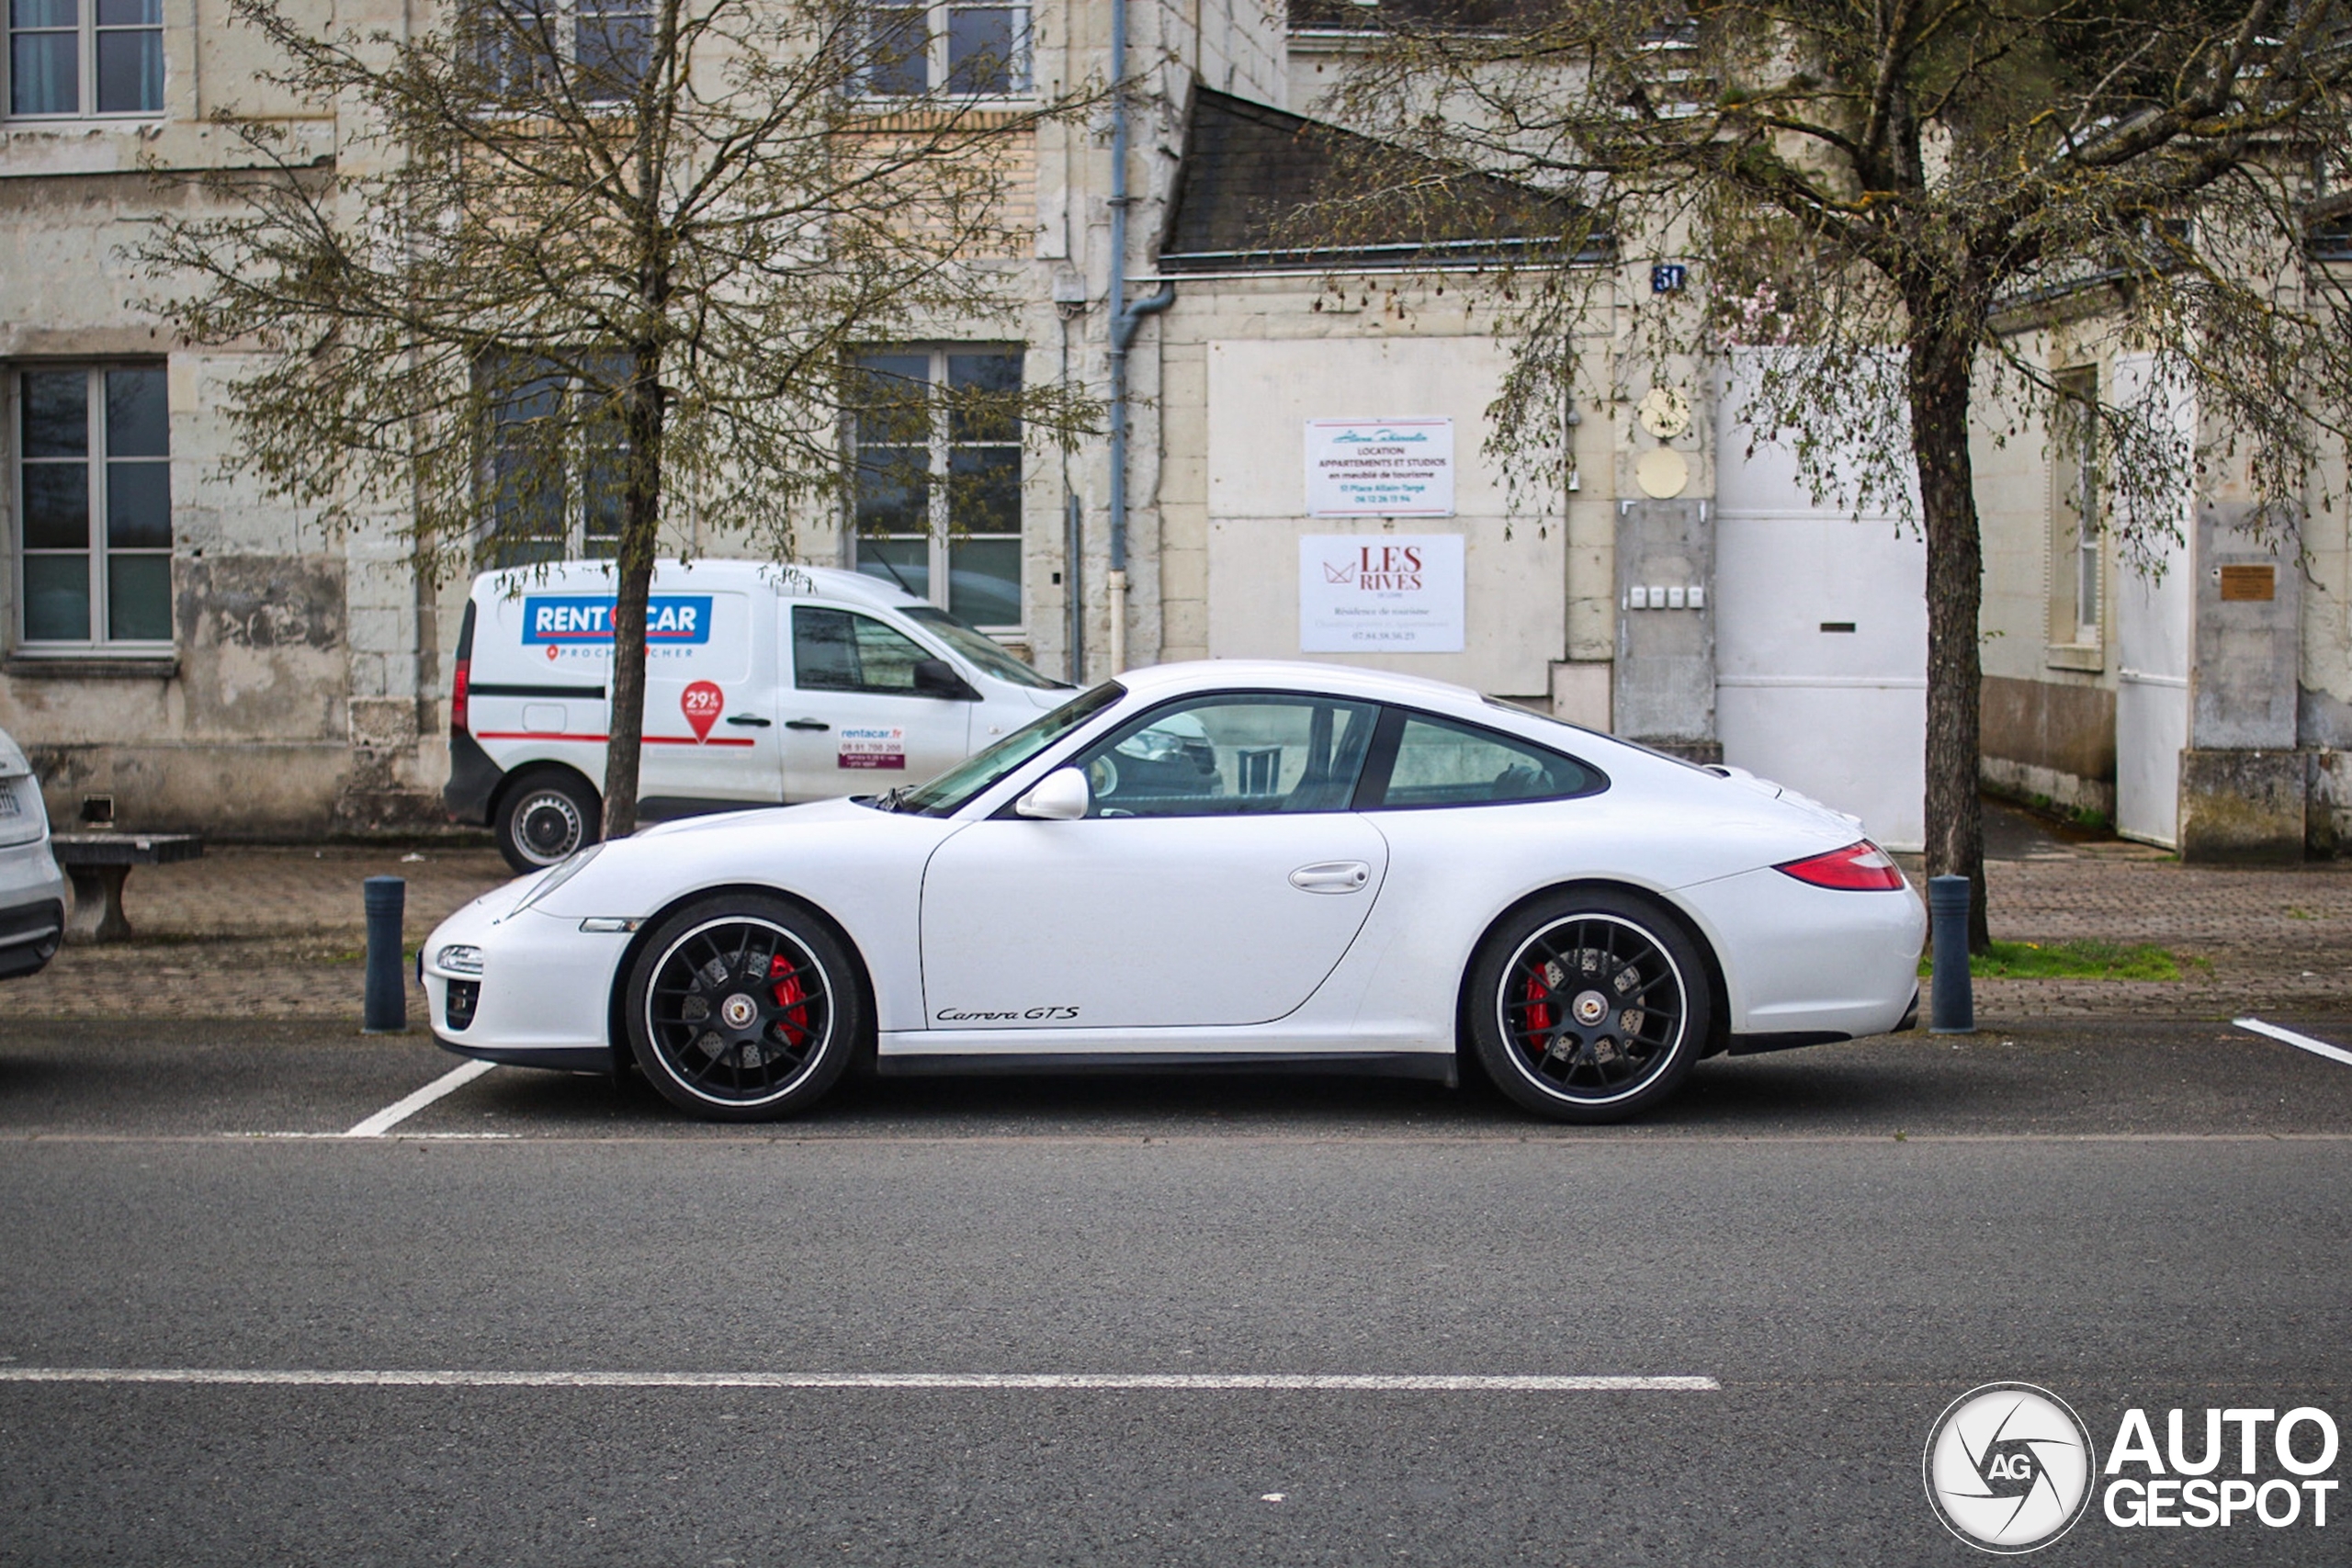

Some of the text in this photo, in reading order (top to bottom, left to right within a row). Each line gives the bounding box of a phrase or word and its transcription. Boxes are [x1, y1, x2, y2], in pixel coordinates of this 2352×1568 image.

[1357, 446, 1405, 456] LOCATION
[1318, 458, 1447, 468] APPARTEMENTS ET STUDIOS
[1392, 470, 1435, 479] tourisme
[1360, 545, 1423, 574] LES
[1360, 573, 1423, 591] RIVES
[1379, 607, 1390, 616] de
[1391, 607, 1430, 616] tourisme
[536, 606, 607, 632] RENT
[650, 649, 694, 658] CHER
[842, 728, 902, 739] rentacar.fr
[936, 1006, 1080, 1021] Carrera GTS
